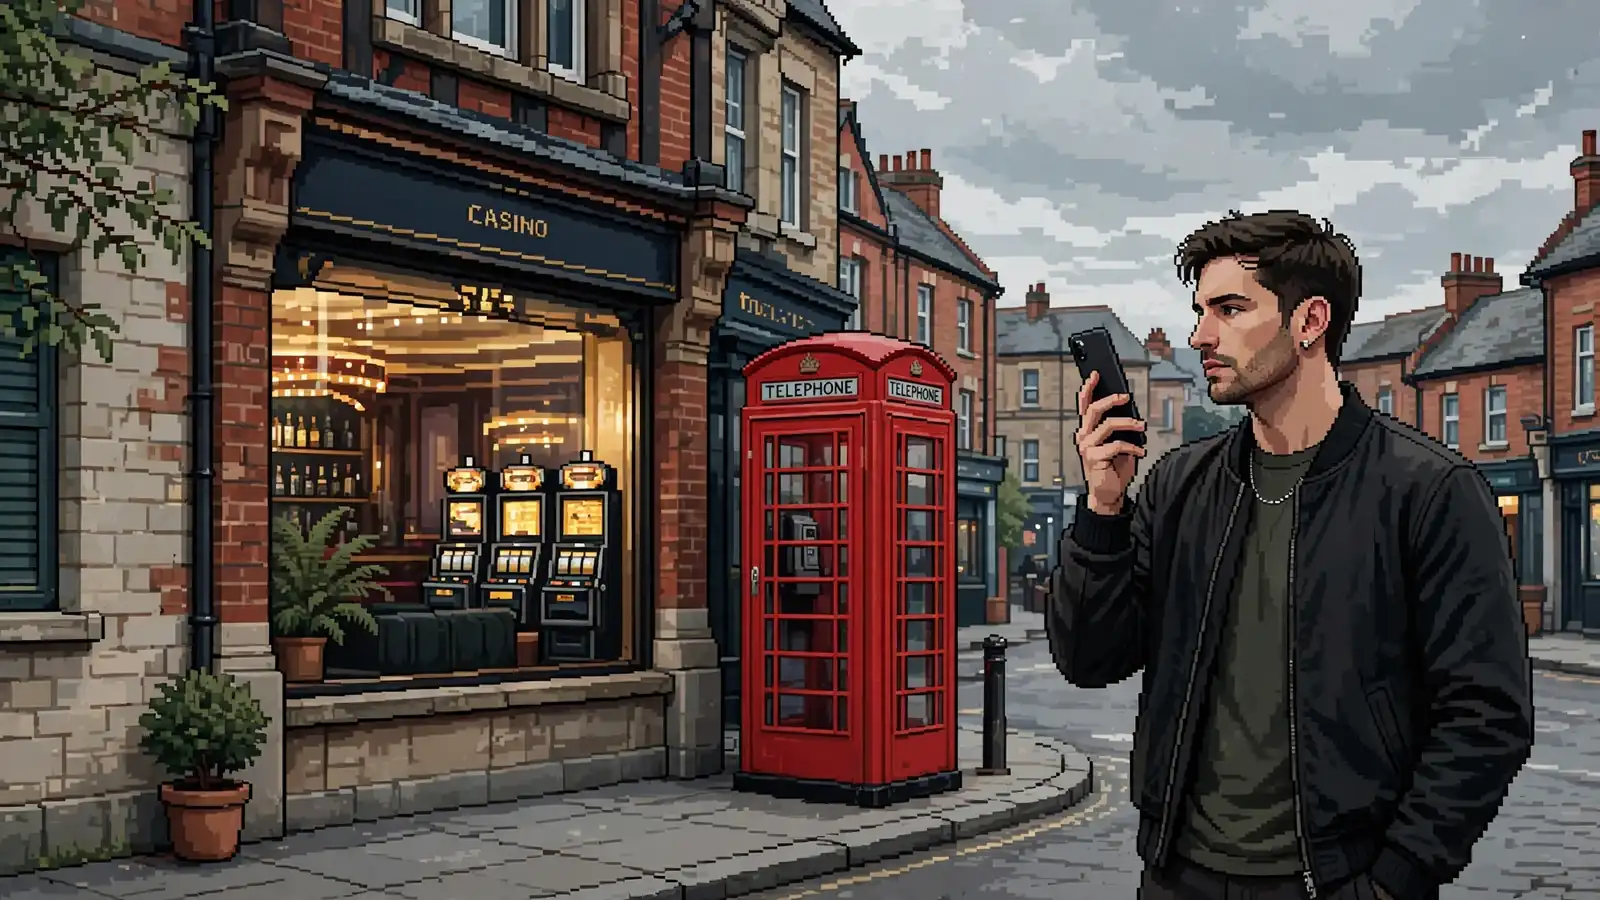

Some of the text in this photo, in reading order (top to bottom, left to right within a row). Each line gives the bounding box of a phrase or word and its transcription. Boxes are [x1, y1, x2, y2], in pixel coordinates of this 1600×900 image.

[468, 204, 548, 238] CASINO
[765, 380, 853, 399] TELEPHONE
[889, 380, 940, 402] TELEPHONE
